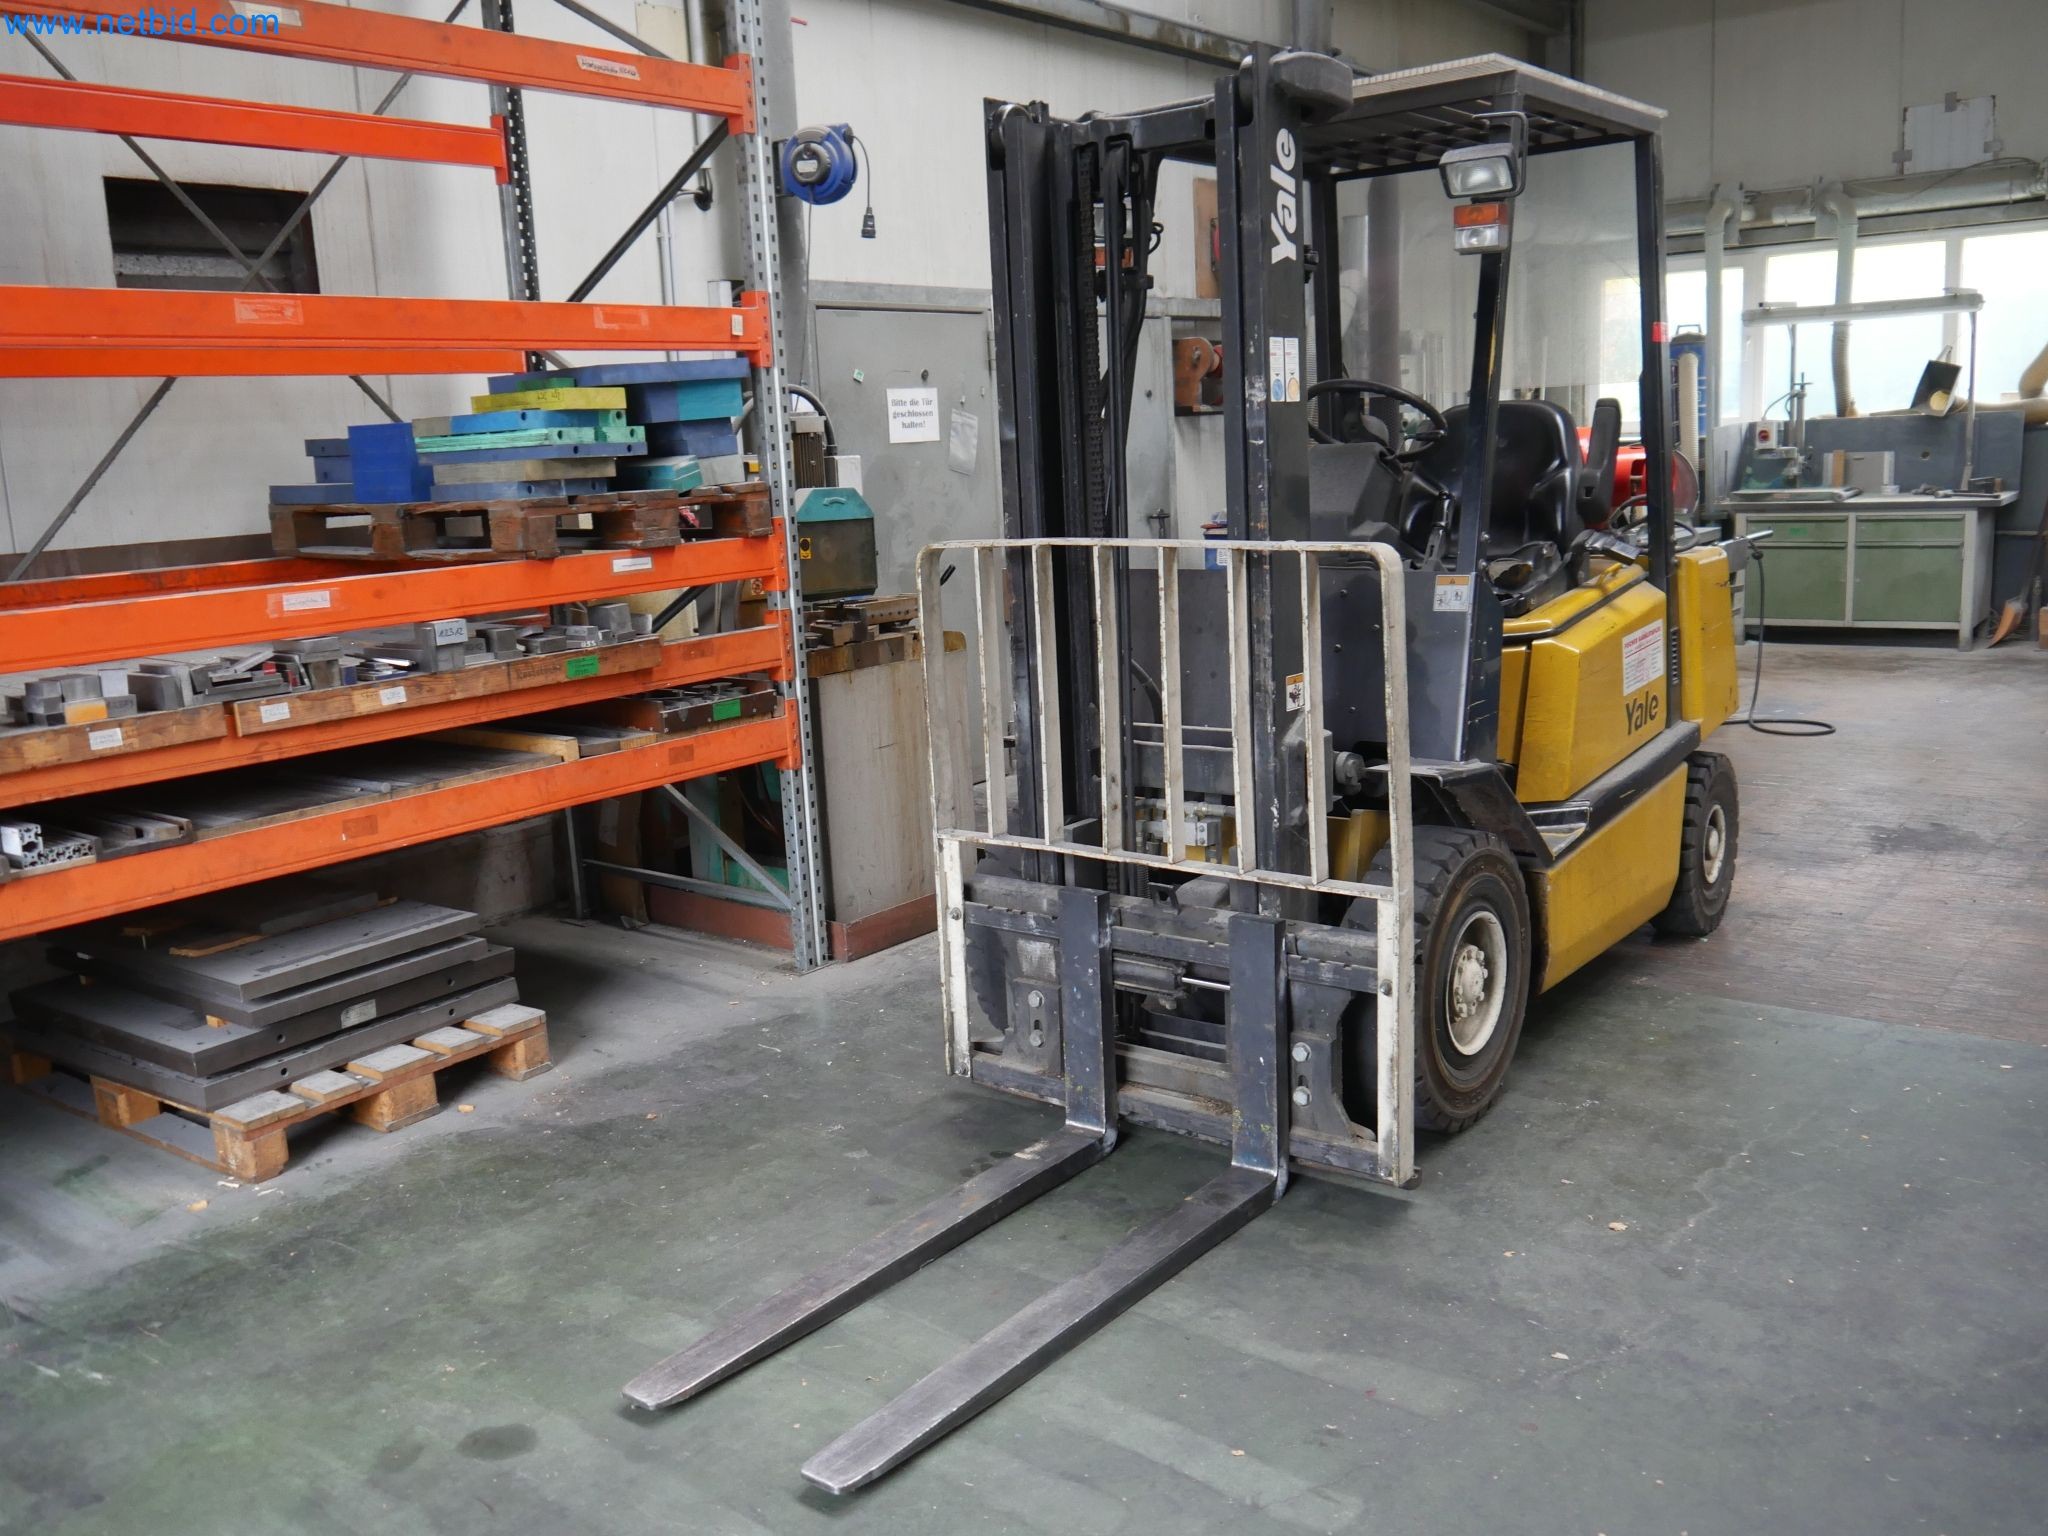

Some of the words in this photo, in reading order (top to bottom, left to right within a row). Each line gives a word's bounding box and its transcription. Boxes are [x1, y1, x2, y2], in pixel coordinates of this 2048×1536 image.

[1270, 128, 1296, 264] Yale
[891, 399, 907, 407] Bitte
[921, 398, 933, 406] Tür
[892, 410, 934, 419] geschlossen
[901, 420, 926, 429] halten!
[1625, 690, 1659, 735] Yale
